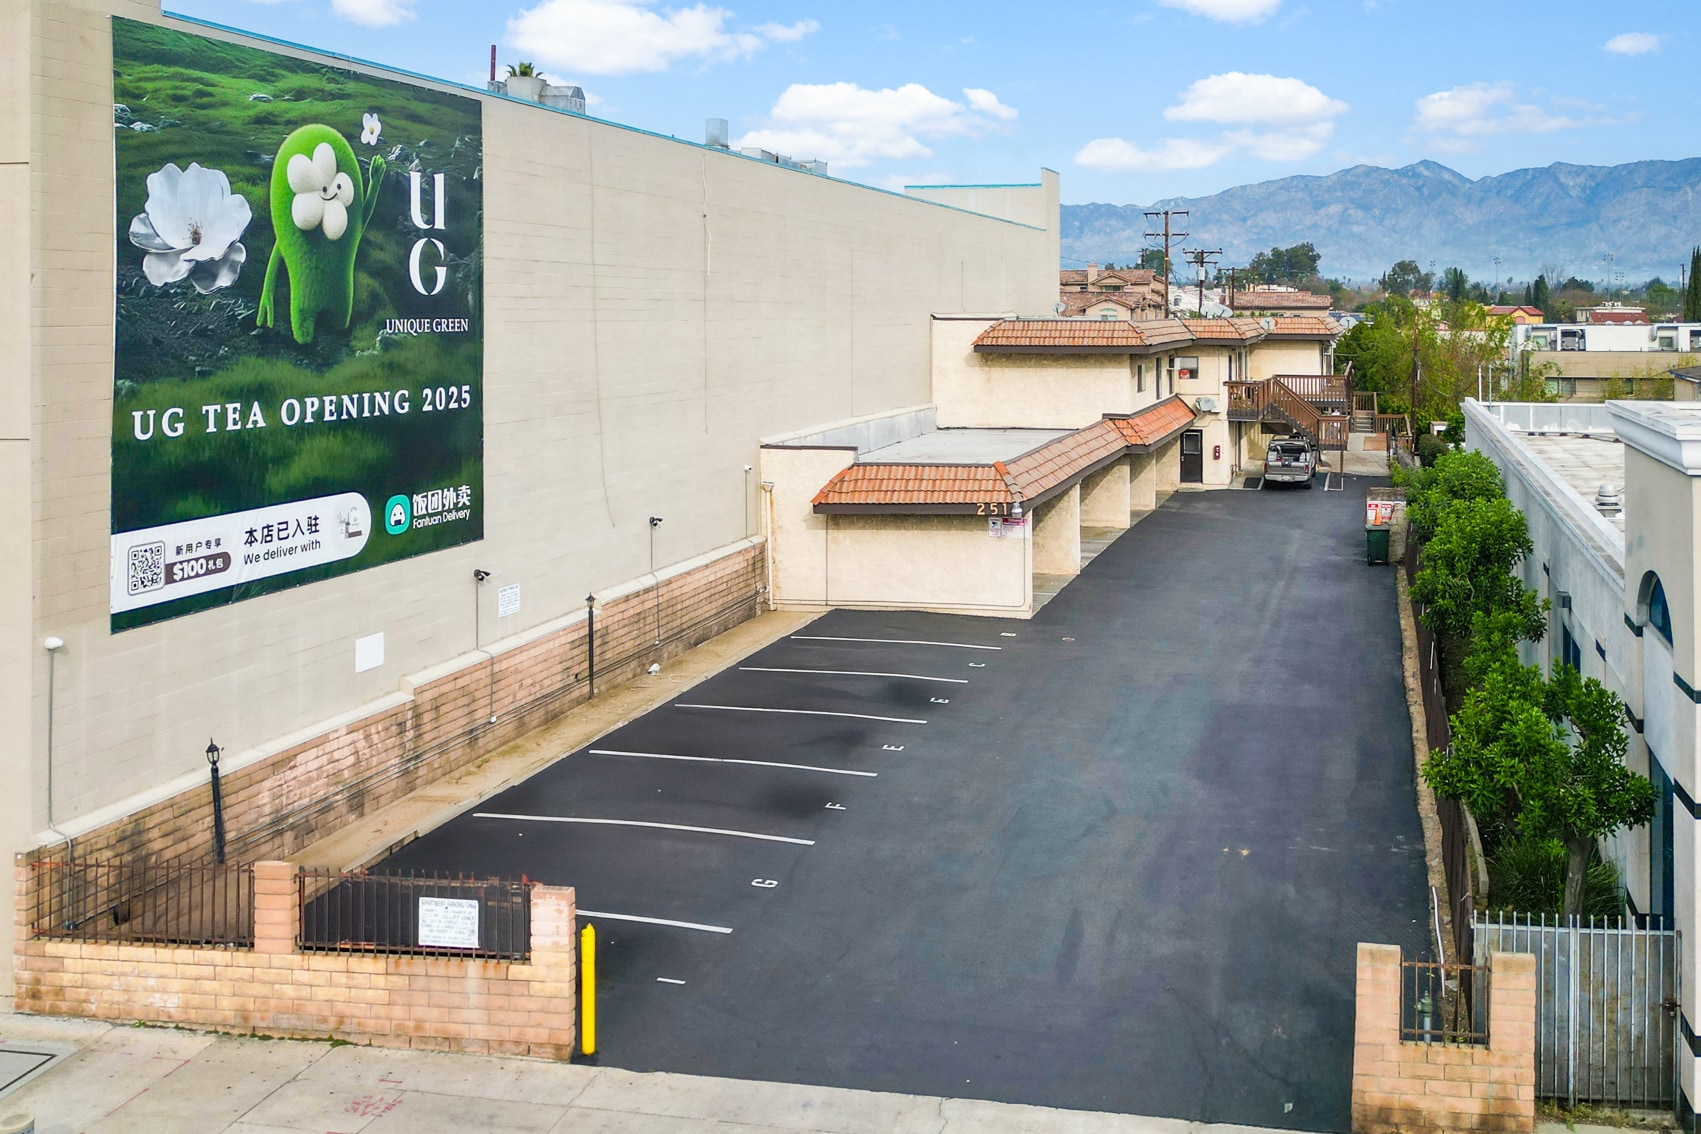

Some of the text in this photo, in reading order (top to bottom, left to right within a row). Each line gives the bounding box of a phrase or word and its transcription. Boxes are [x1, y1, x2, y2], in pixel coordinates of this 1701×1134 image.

[386, 318, 469, 336] UNIQUE GREEN
[131, 385, 471, 441] UG TEA OPENING 2025
[412, 484, 471, 517] 饭团外卖
[976, 502, 1008, 516] 251
[412, 508, 471, 529] Fantuan Delivery
[244, 514, 320, 547] 本店已入驻
[175, 537, 222, 556] 新用户专享
[243, 539, 321, 565] We deliver with
[751, 878, 779, 888] G
